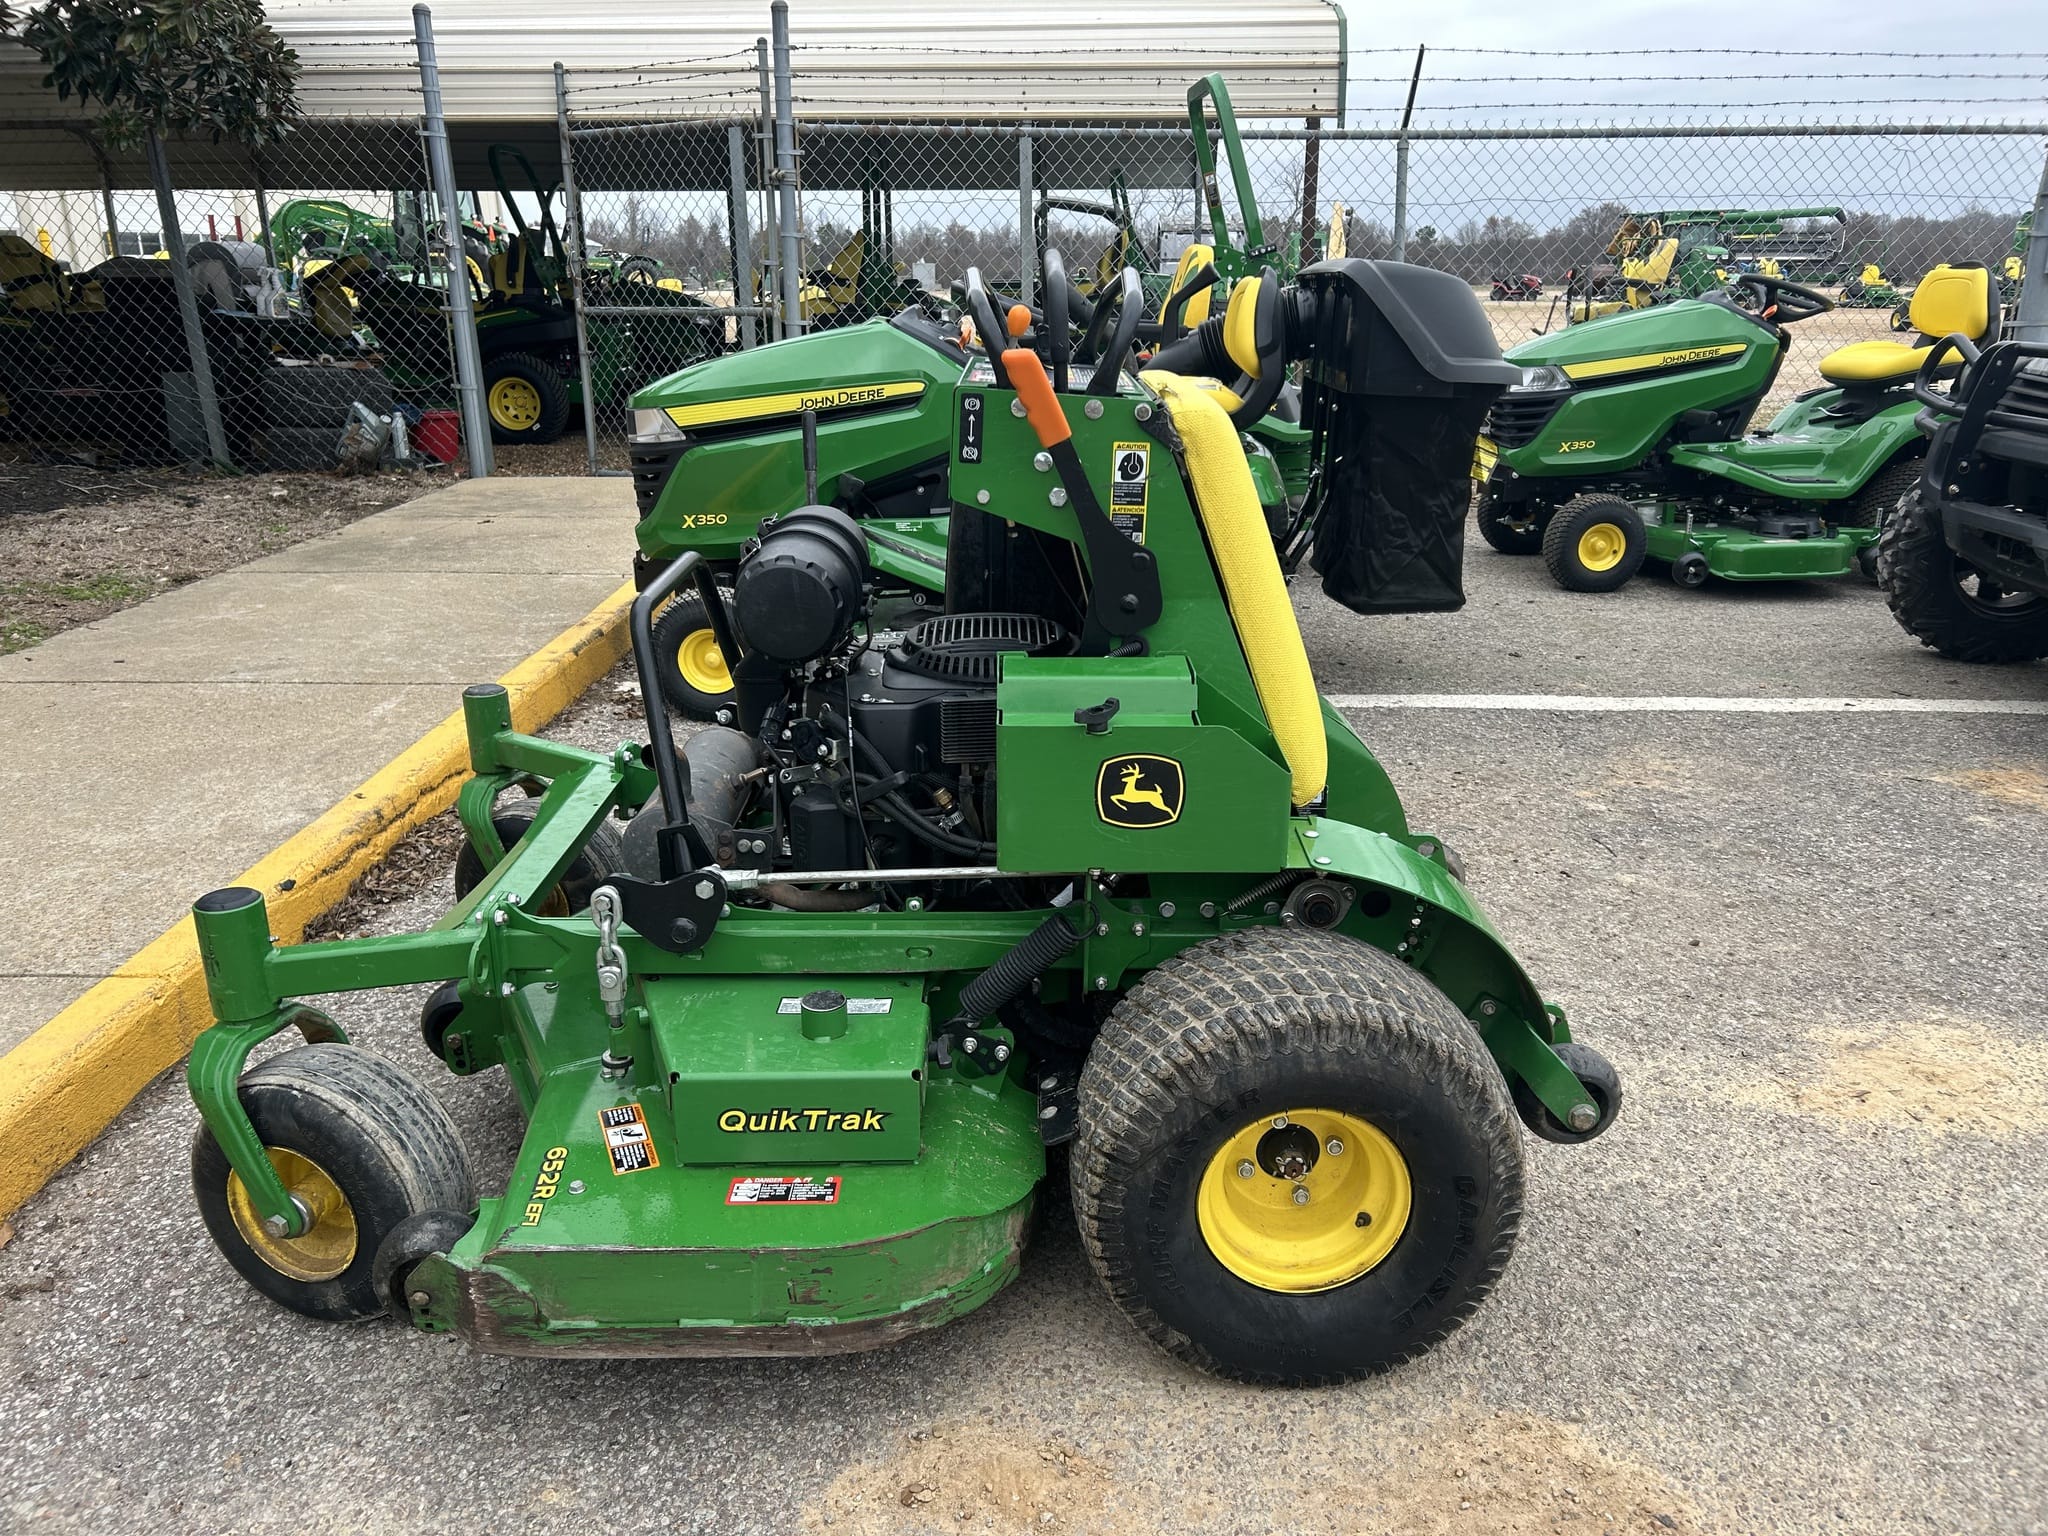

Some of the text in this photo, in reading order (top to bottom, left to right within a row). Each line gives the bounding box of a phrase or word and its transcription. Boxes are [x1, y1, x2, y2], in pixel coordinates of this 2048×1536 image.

[1660, 348, 1721, 367] JOHN DEERE
[797, 387, 886, 411] JOHN DEERE
[1558, 440, 1596, 453] X350
[681, 514, 728, 529] X350
[718, 1108, 890, 1132] QuikTrak
[520, 1145, 569, 1227] 652R EFI
